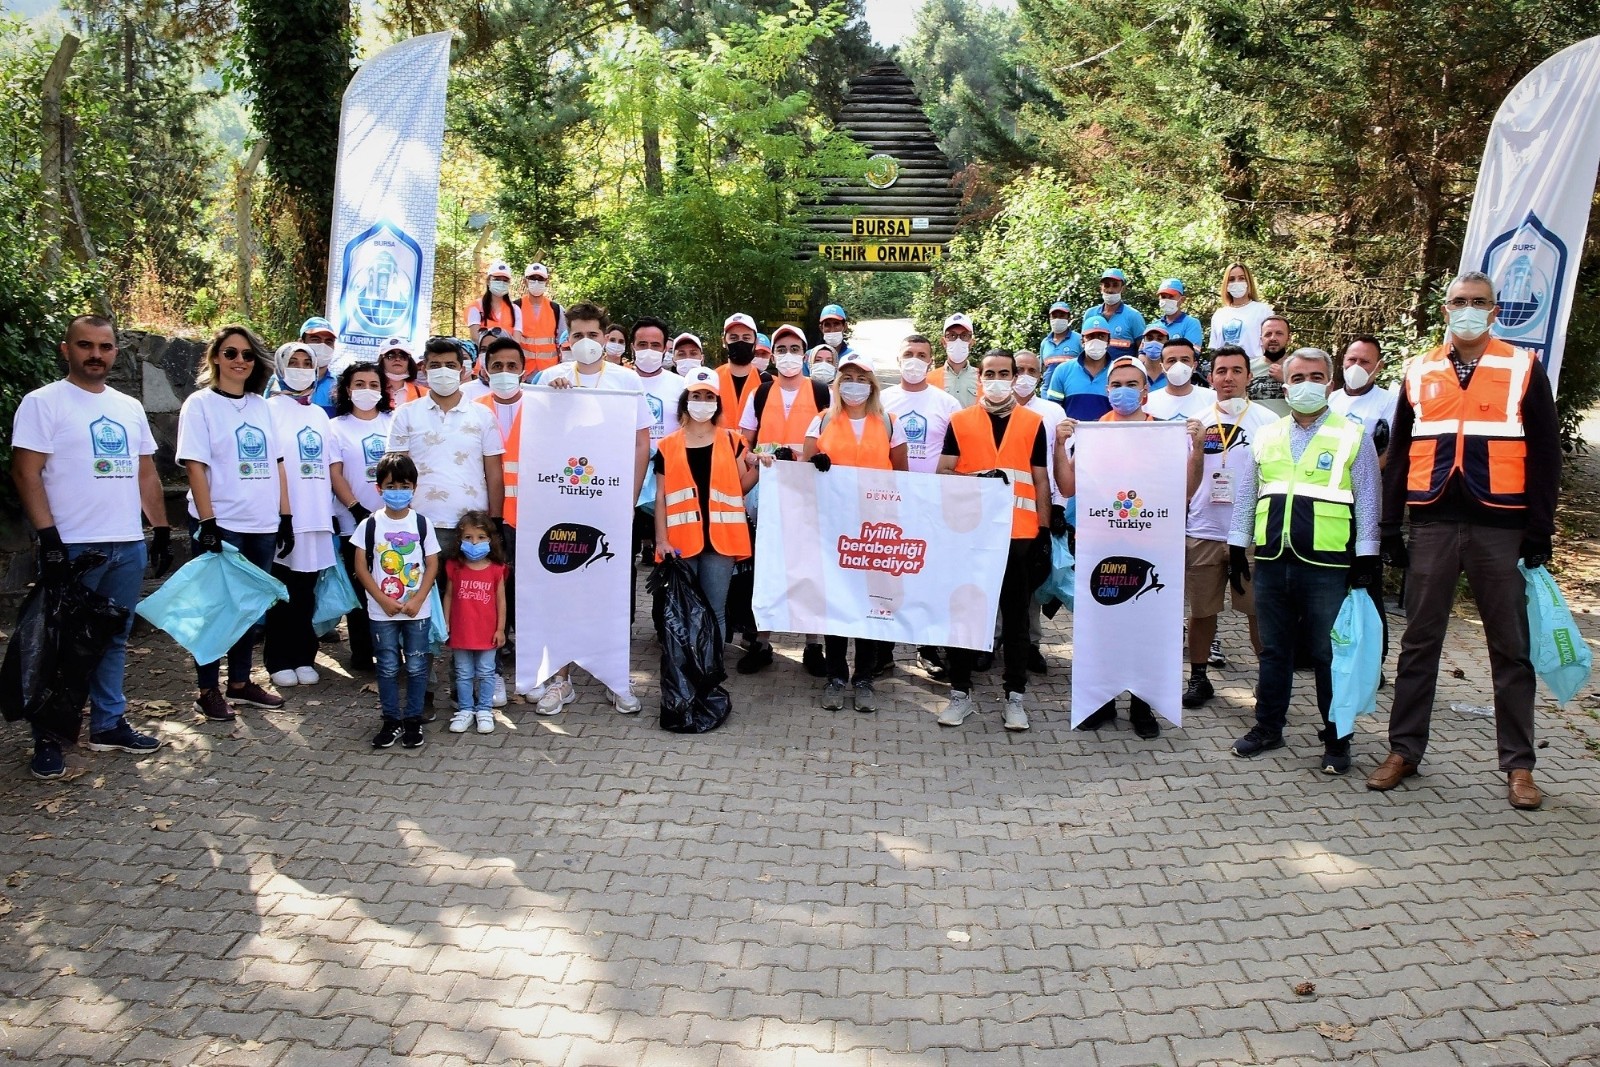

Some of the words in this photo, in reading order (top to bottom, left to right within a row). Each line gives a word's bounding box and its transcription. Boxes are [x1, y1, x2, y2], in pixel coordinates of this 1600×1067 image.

[856, 220, 906, 235] BURSA
[373, 240, 396, 248] BURSA
[538, 473, 564, 483] Let's
[591, 476, 605, 486] do
[608, 477, 620, 487] it!
[558, 485, 603, 499] Türkiye
[1089, 508, 1114, 518] Let's
[1140, 508, 1154, 518] do
[1157, 508, 1169, 518] it!
[1108, 519, 1152, 532] Türkiye
[549, 529, 577, 541] DÜNYA
[863, 525, 900, 543] iyilik
[548, 542, 589, 553] TEMİZLİK
[840, 539, 923, 560] beraberliği
[546, 553, 569, 565] GÜNÜ
[842, 554, 871, 568] hak
[872, 557, 921, 574] ediyor
[1100, 562, 1127, 574] DÜNYA
[1097, 586, 1119, 597] GÜNÜ
